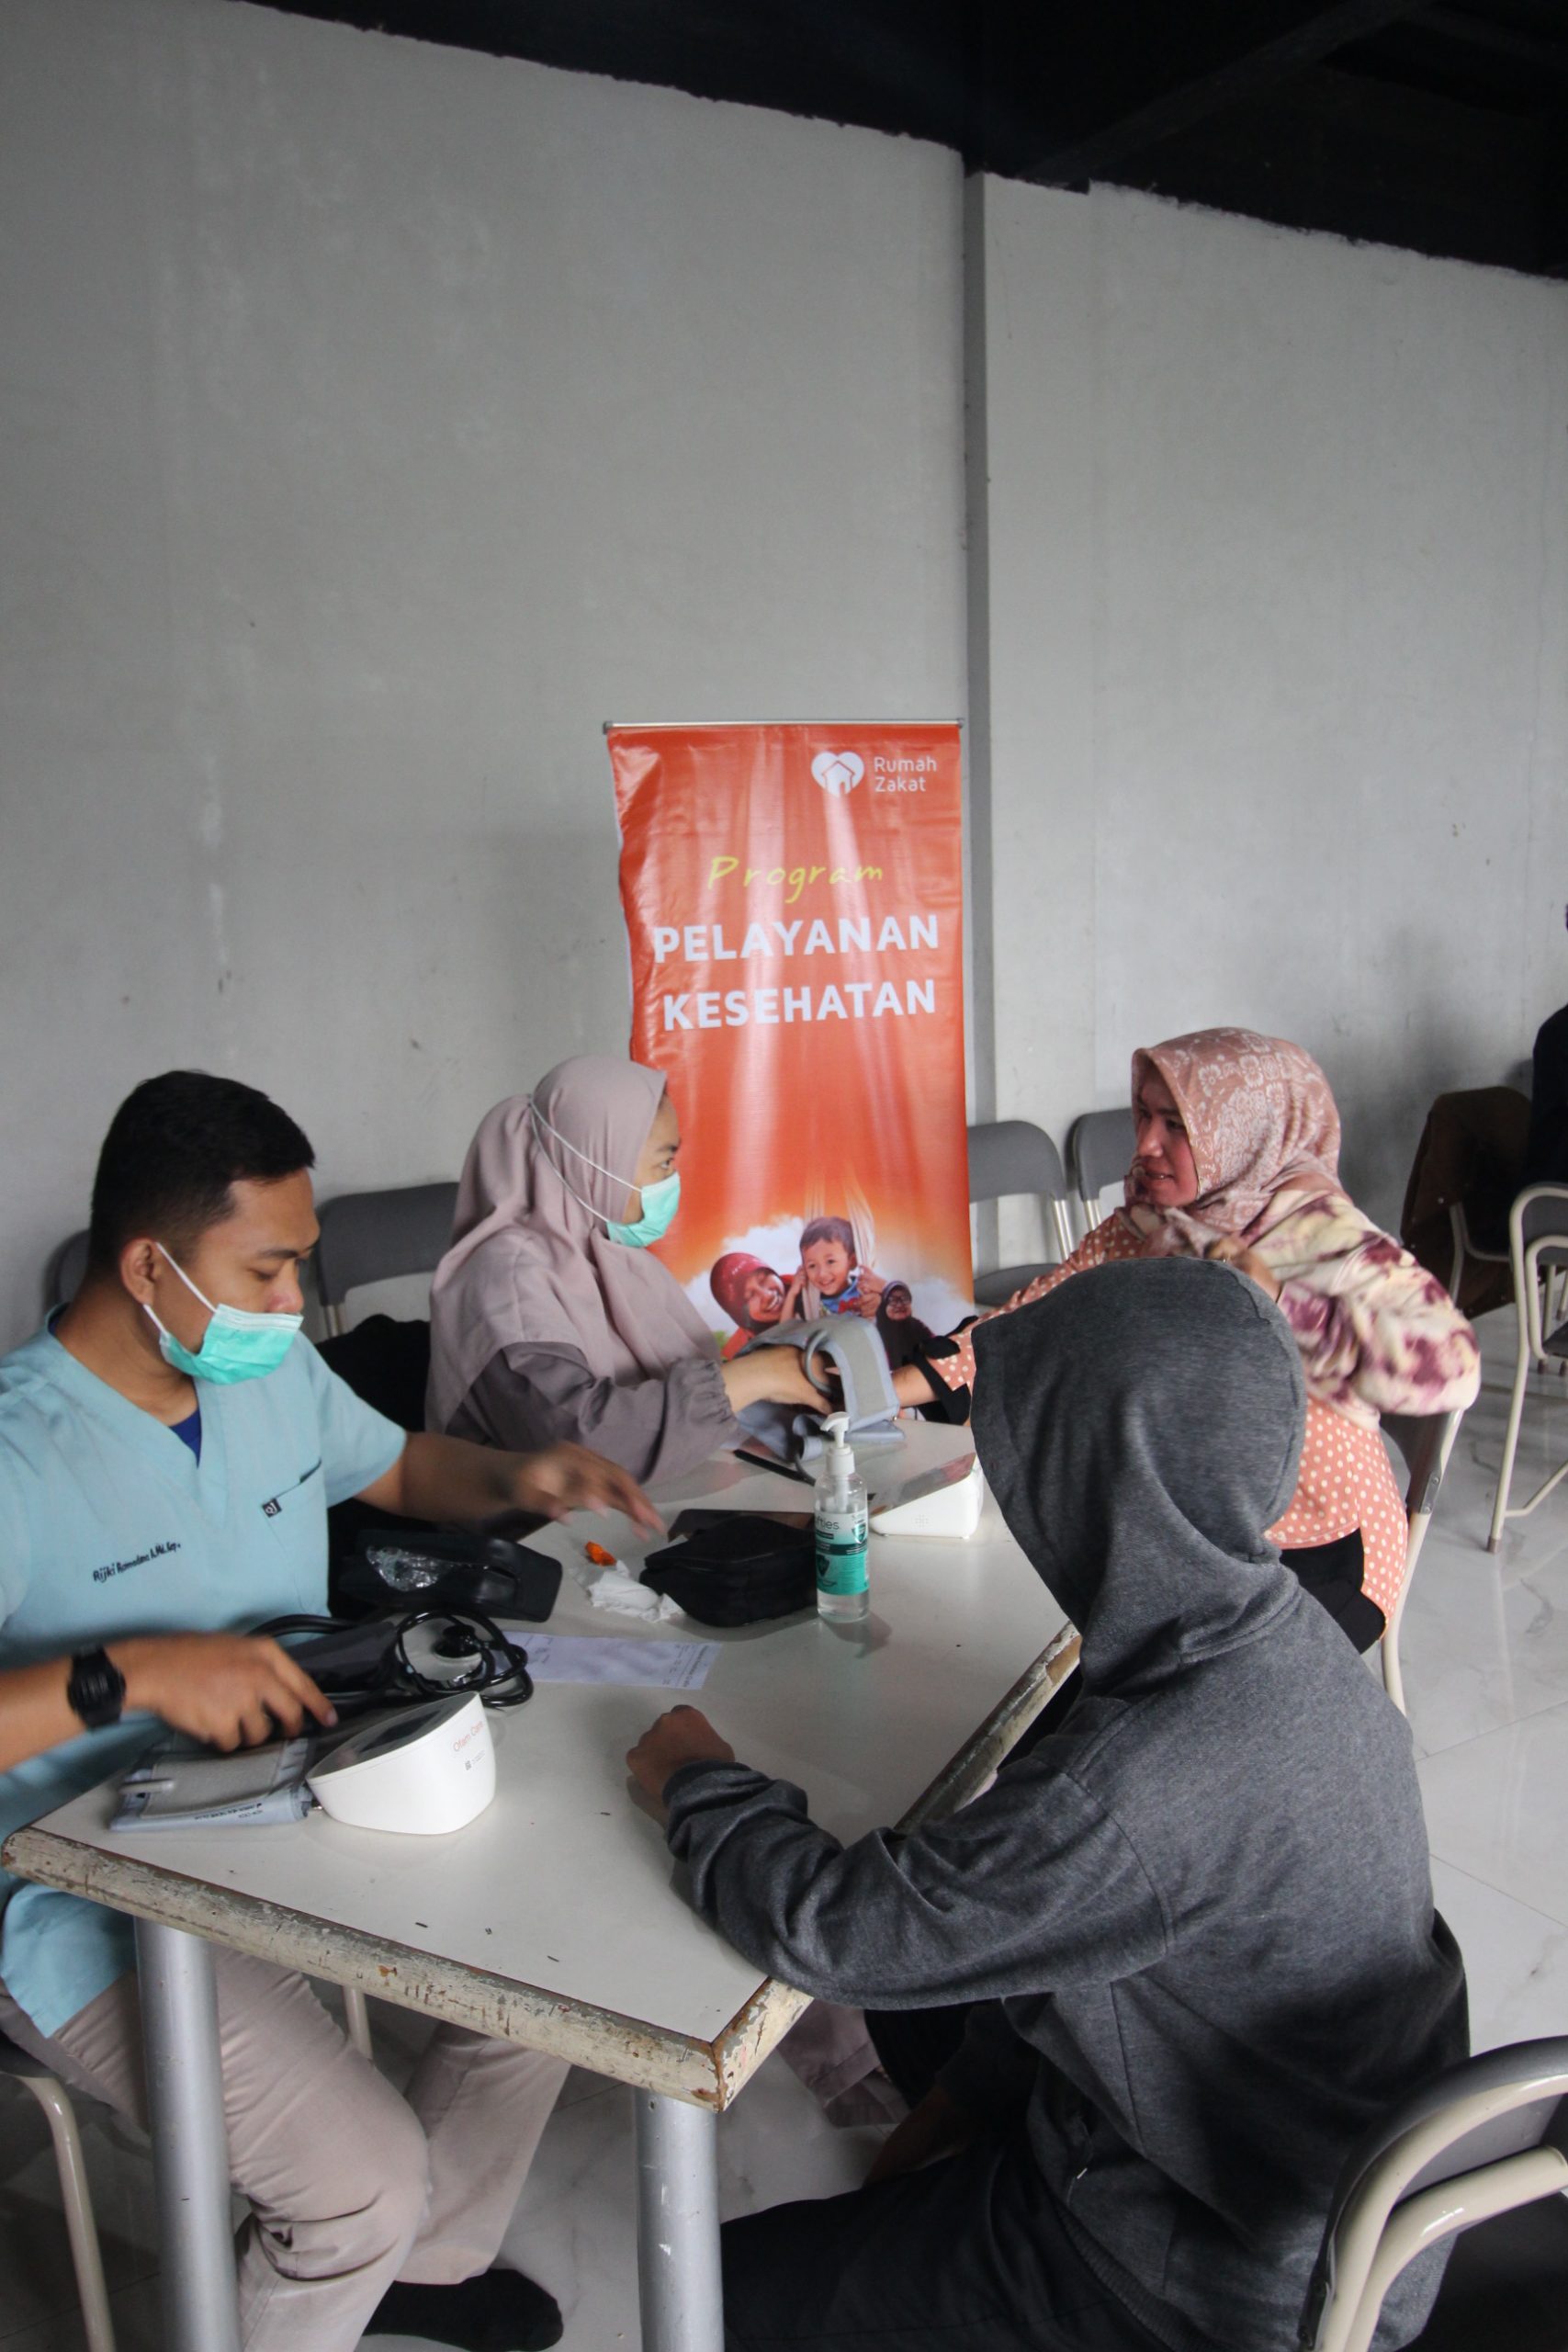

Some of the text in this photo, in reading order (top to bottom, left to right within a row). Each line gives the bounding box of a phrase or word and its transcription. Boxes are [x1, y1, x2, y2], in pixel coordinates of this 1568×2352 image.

[874, 756, 937, 774] Rumah
[874, 775, 926, 793] Zakat
[707, 856, 883, 903] Program
[654, 914, 939, 963] PELAYANAN
[663, 979, 935, 1031] KESEHATAN
